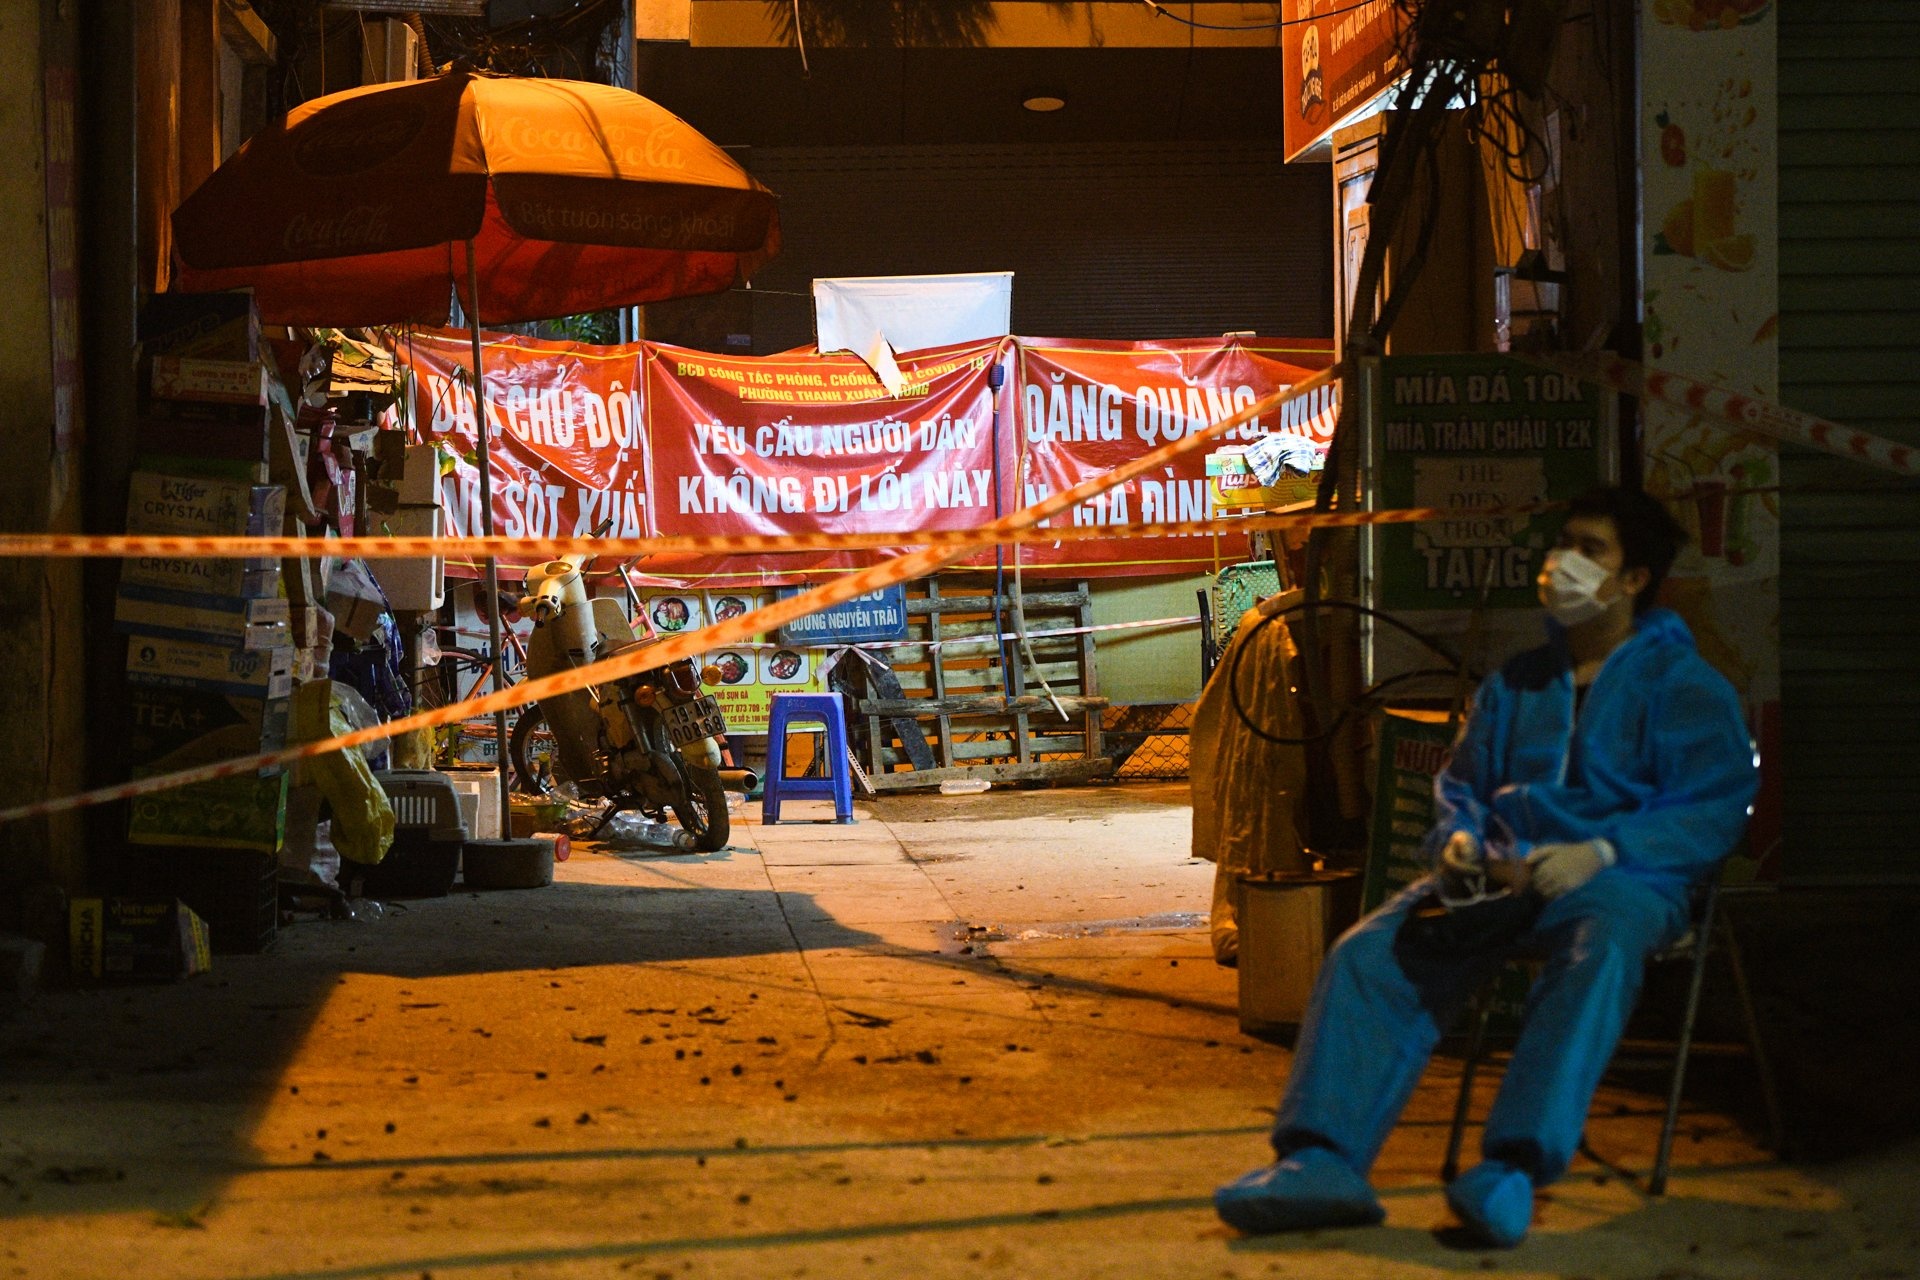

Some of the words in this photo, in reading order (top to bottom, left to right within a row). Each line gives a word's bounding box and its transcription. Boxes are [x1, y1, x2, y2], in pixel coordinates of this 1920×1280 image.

[708, 365, 744, 382] CÔNG
[747, 367, 773, 385] TÁC
[776, 369, 827, 388] PHÒNG,
[738, 384, 794, 402] PHƯỜNG
[796, 388, 843, 403] THANH
[845, 386, 883, 401] XUÂN
[1394, 370, 1457, 404] MÍA
[1467, 369, 1512, 403] ĐÁ
[1523, 373, 1585, 403] 10K
[507, 364, 575, 448] CHỦ
[1280, 384, 1338, 439] MU
[693, 420, 746, 456] YÊU
[755, 415, 814, 458] CẦU
[822, 415, 911, 456] NGƯỜI
[919, 413, 976, 453] DÂN
[1386, 416, 1427, 451] MÍA
[1433, 414, 1488, 451] TRÂN
[1492, 414, 1548, 450] CHÂU
[1554, 420, 1593, 449] 12K
[505, 463, 566, 541] SỐT
[678, 467, 806, 514] KHÔNG
[812, 475, 849, 513] ĐI
[860, 459, 914, 511] LỐI
[921, 461, 992, 509] NÀY
[144, 500, 216, 522] CRYSTAL
[138, 556, 210, 578] CRYSTAL
[828, 606, 871, 630] NGUYỄN
[872, 606, 898, 626] TRÃI
[471, 641, 510, 674] BÁH
[81, 906, 94, 979] ONCHA
